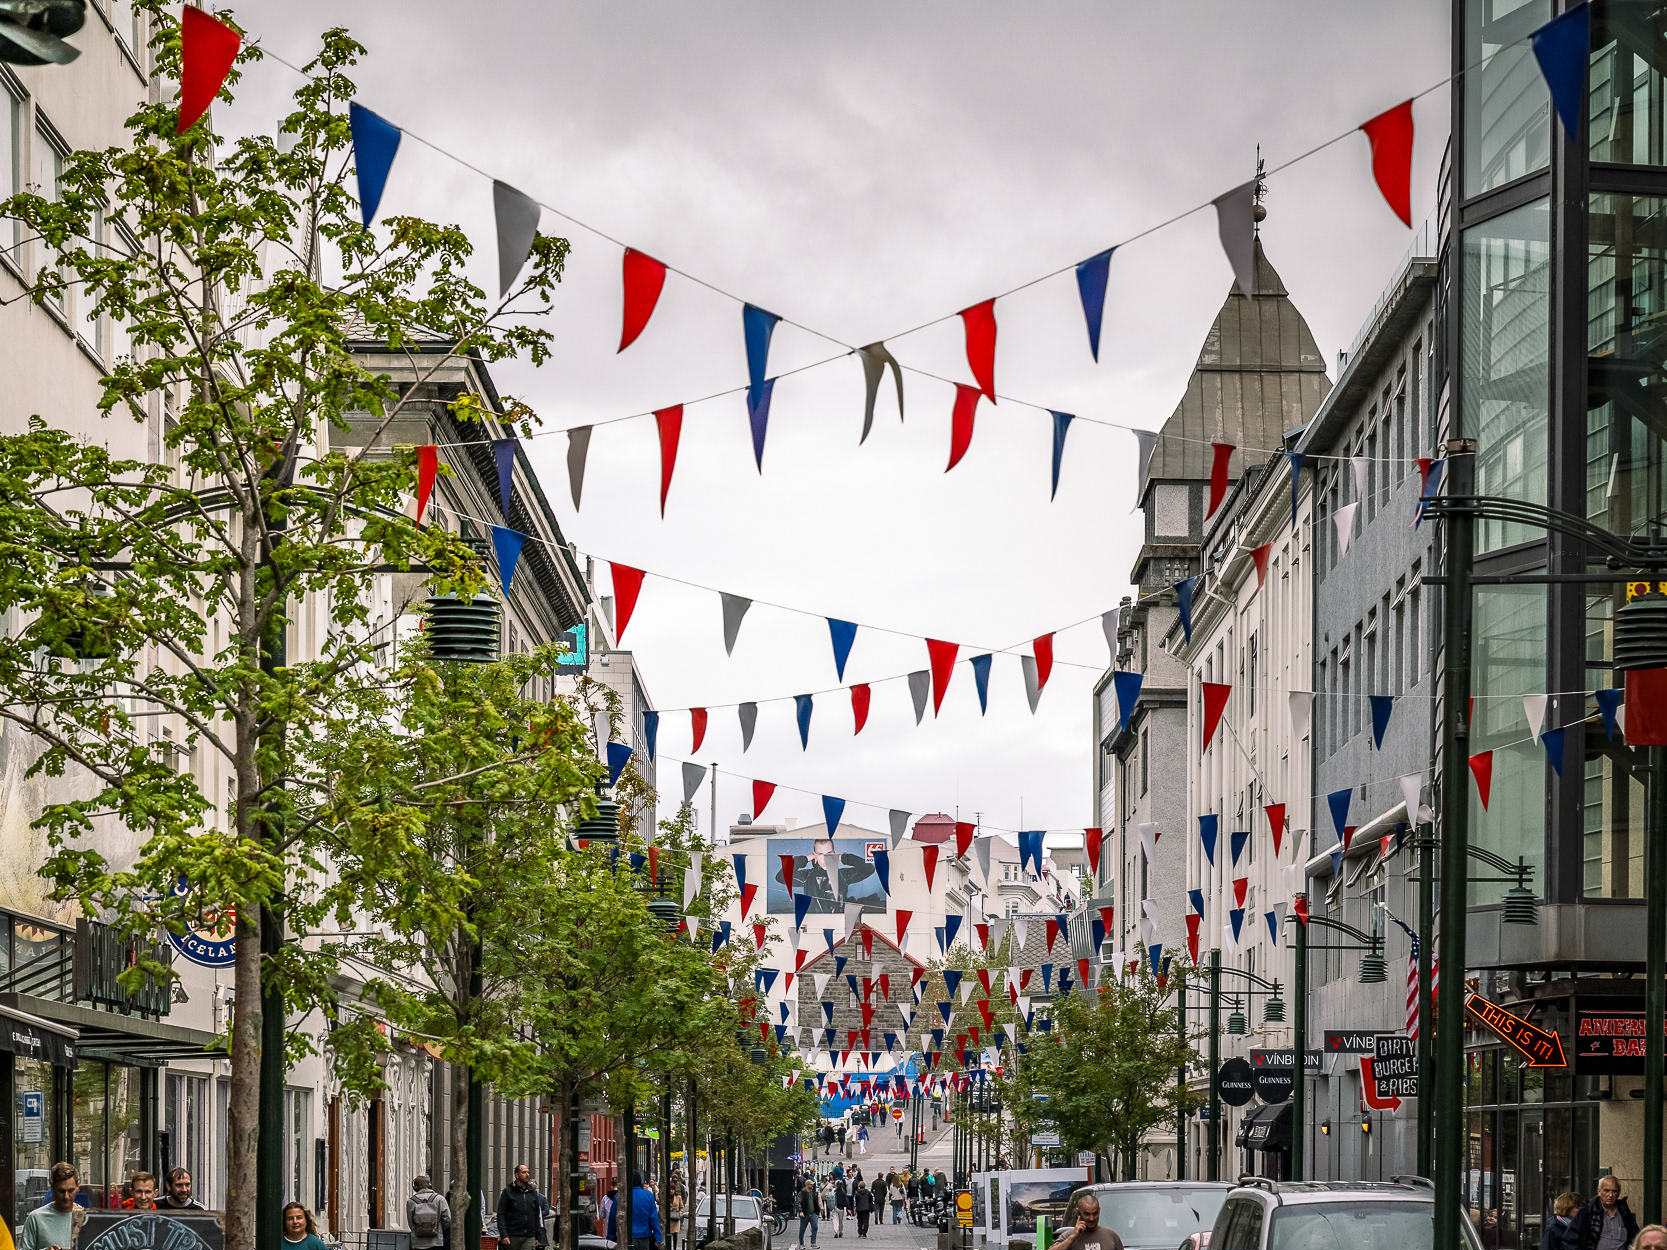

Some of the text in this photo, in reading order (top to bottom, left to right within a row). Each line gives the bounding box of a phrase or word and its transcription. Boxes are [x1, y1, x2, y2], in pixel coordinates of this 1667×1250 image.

[1480, 1002, 1554, 1060] THIS IS IT!
[1579, 1018, 1667, 1037] AMERI
[1343, 1033, 1375, 1049] VÍNB
[1379, 1038, 1415, 1056] DIRTY
[1222, 1080, 1252, 1089] GUINNESS
[1258, 1075, 1291, 1084] GUINNESS
